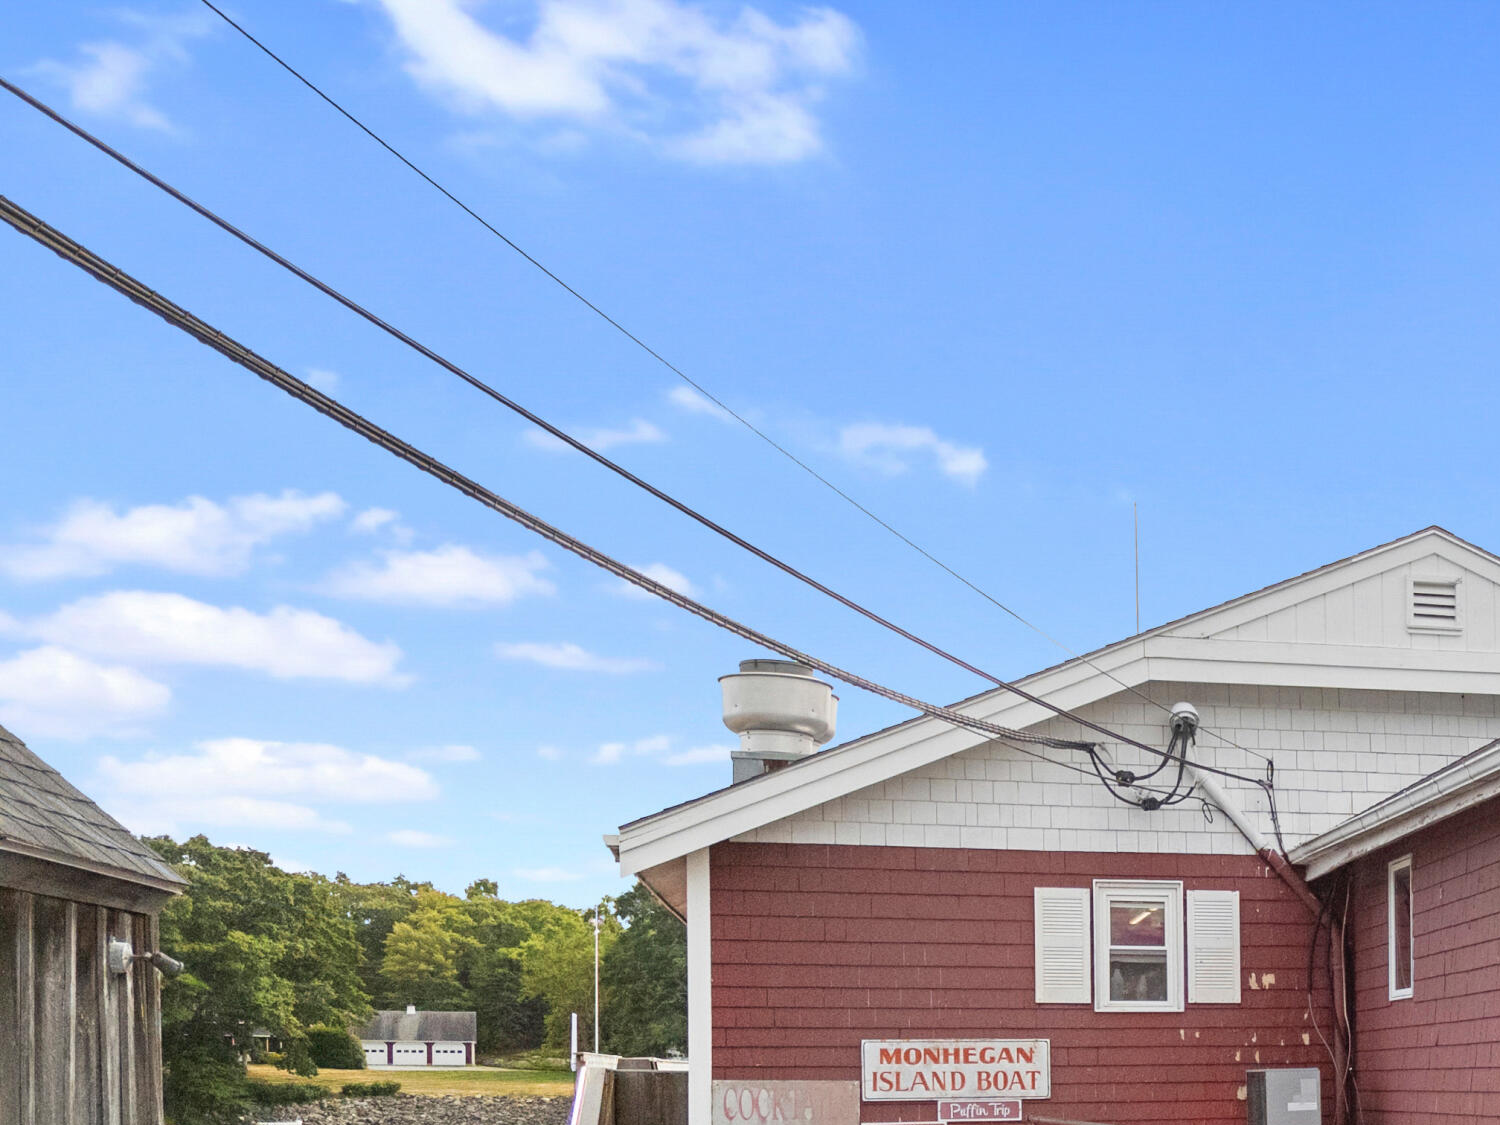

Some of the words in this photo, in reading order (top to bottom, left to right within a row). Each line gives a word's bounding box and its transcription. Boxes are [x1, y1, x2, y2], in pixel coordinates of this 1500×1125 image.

[879, 1047, 1034, 1065] MONHEGAN
[872, 1071, 966, 1092] ISLAND
[976, 1070, 1041, 1091] BOAT
[949, 1103, 988, 1119] Puffin
[988, 1102, 1011, 1118] Trip
